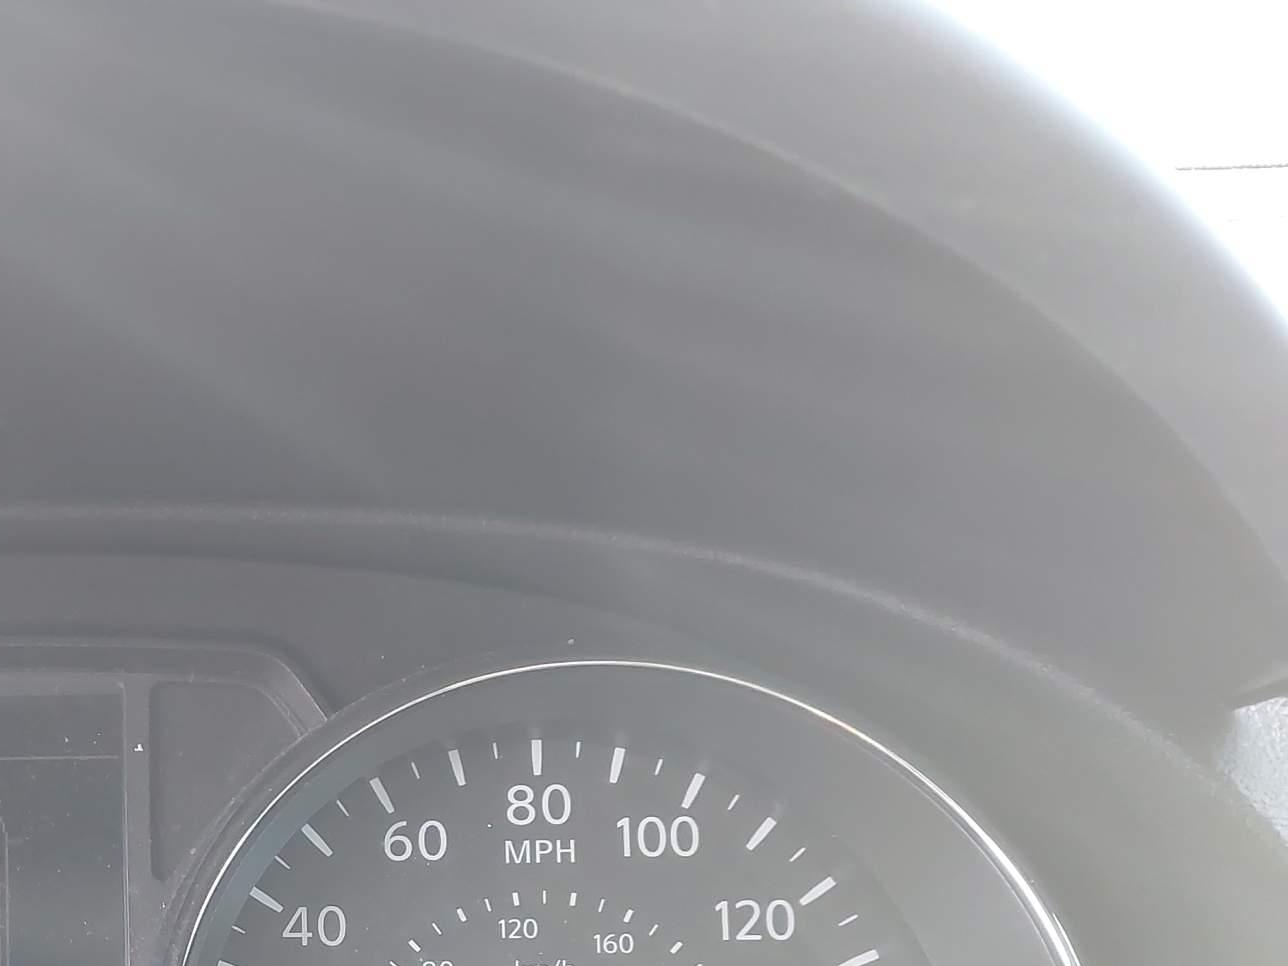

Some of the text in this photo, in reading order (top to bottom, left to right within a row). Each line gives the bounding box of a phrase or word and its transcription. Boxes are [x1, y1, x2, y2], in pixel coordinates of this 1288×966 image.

[506, 783, 572, 826] 80
[384, 820, 448, 862] 60
[504, 839, 577, 864] MPH
[616, 815, 700, 858] 100
[281, 904, 347, 947] 40
[498, 918, 539, 940] 120
[715, 899, 796, 941] 120
[593, 933, 635, 955] 160
